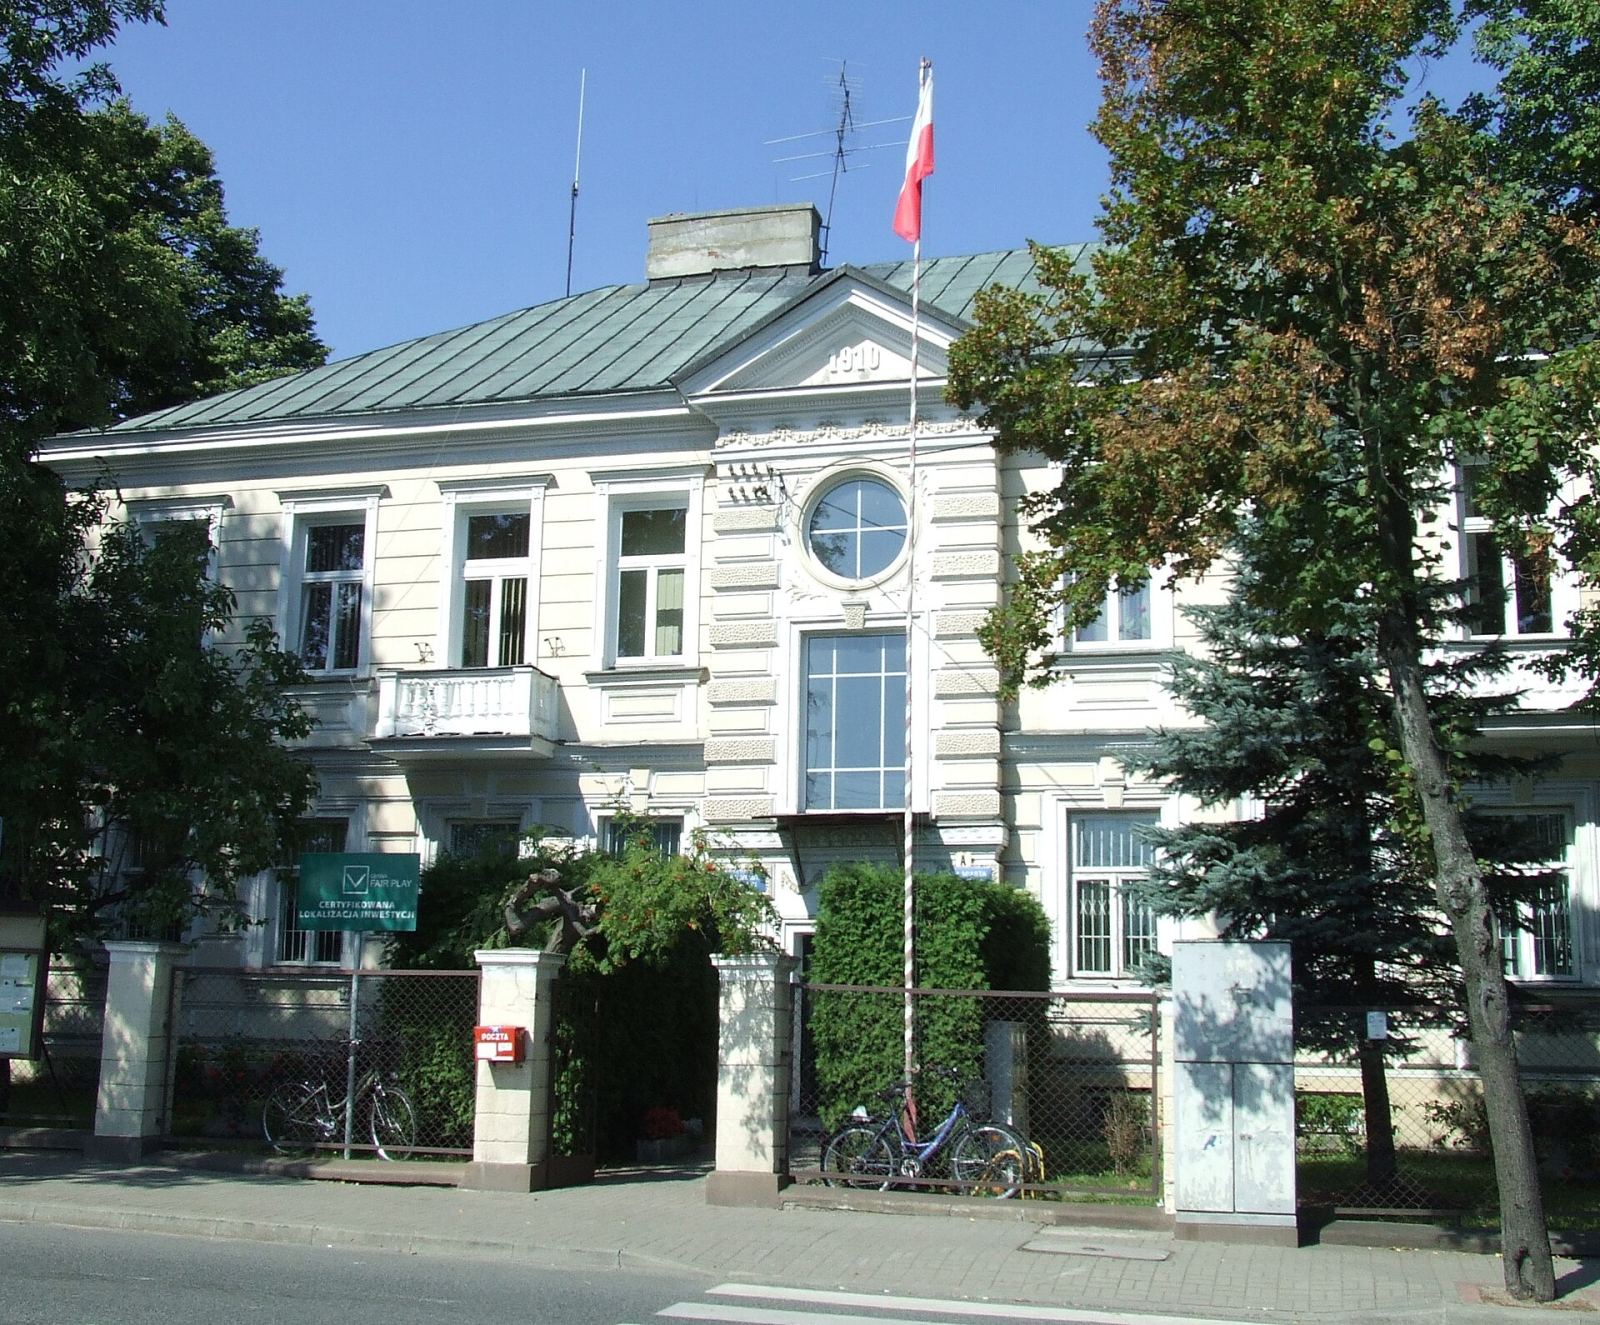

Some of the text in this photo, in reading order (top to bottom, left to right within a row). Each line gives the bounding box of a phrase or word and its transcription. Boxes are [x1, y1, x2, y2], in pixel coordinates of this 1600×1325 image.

[829, 347, 880, 374] 1910
[370, 879, 412, 888] FAIR PLAY
[319, 901, 396, 909] CERTYFIKOWANA
[299, 910, 415, 919] LOKALIZACJA INWESTYCJI
